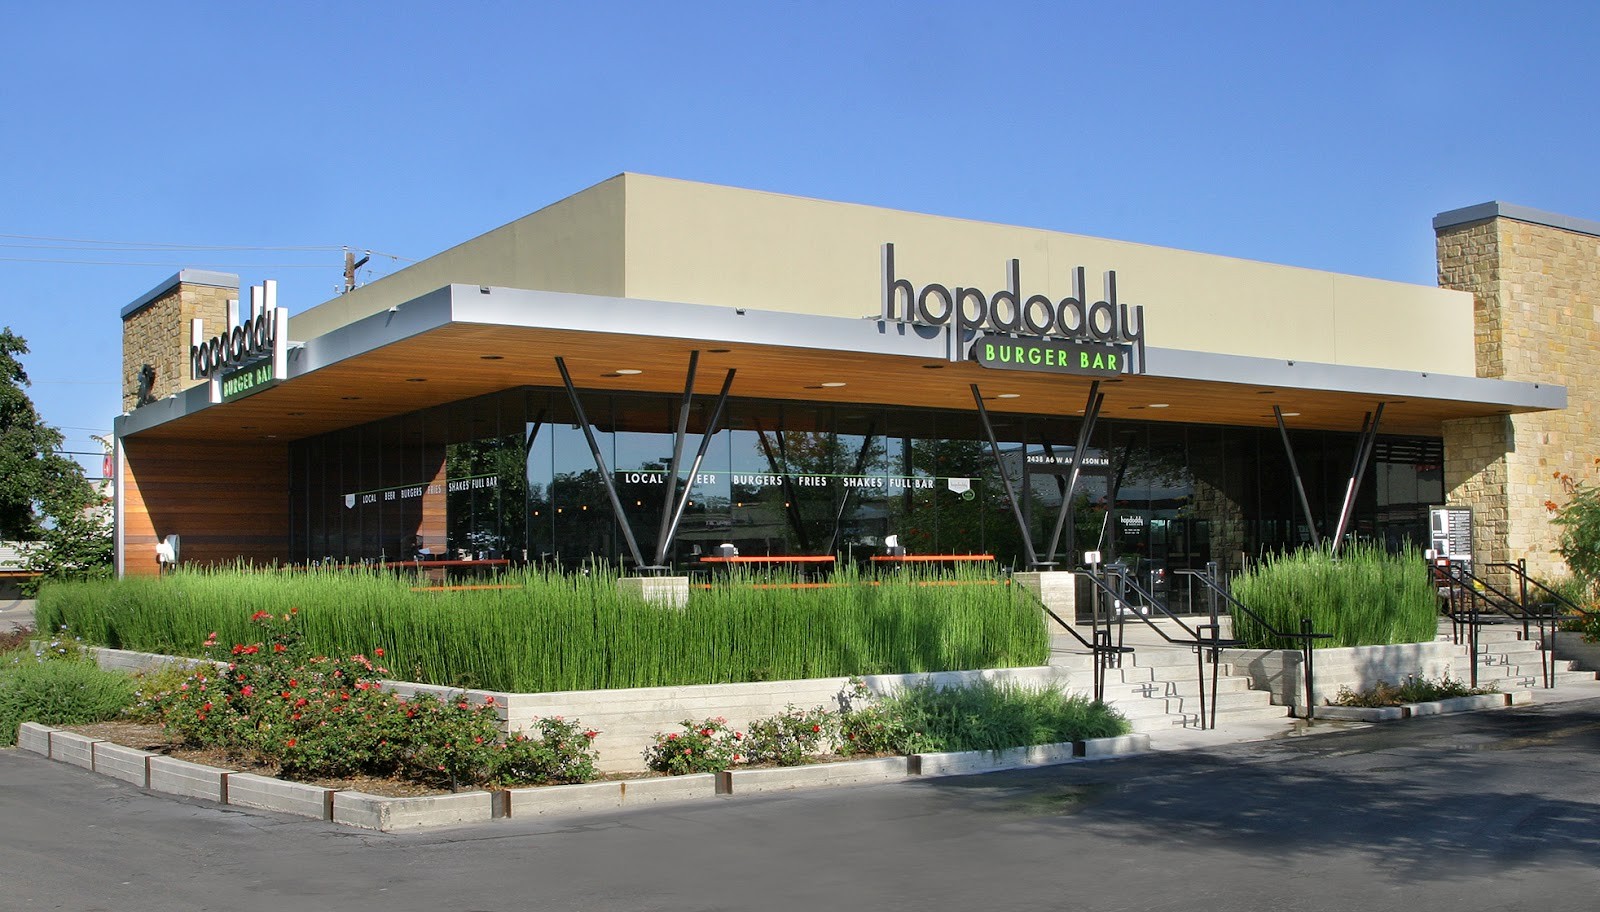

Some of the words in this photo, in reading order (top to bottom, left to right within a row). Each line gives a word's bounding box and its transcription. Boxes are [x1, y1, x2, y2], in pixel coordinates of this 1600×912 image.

[882, 243, 1146, 374] hopdoddy
[985, 344, 1068, 367] BURGER
[1080, 352, 1117, 371] BAR
[223, 372, 254, 397] BURGER
[362, 493, 377, 504] LOCAL
[384, 490, 396, 501] BEER
[401, 487, 423, 499] BURGERS
[427, 484, 442, 495] FRIES
[448, 481, 470, 492] SHAKES
[471, 478, 485, 489] FULL
[486, 476, 498, 487] BAR
[625, 473, 663, 484] LOCAL
[693, 474, 716, 484] EER
[733, 475, 783, 486] BURGERS
[798, 476, 827, 487] FRIES
[843, 477, 883, 488] SHAKES
[889, 478, 912, 489] FULL
[915, 478, 934, 489] BAR
